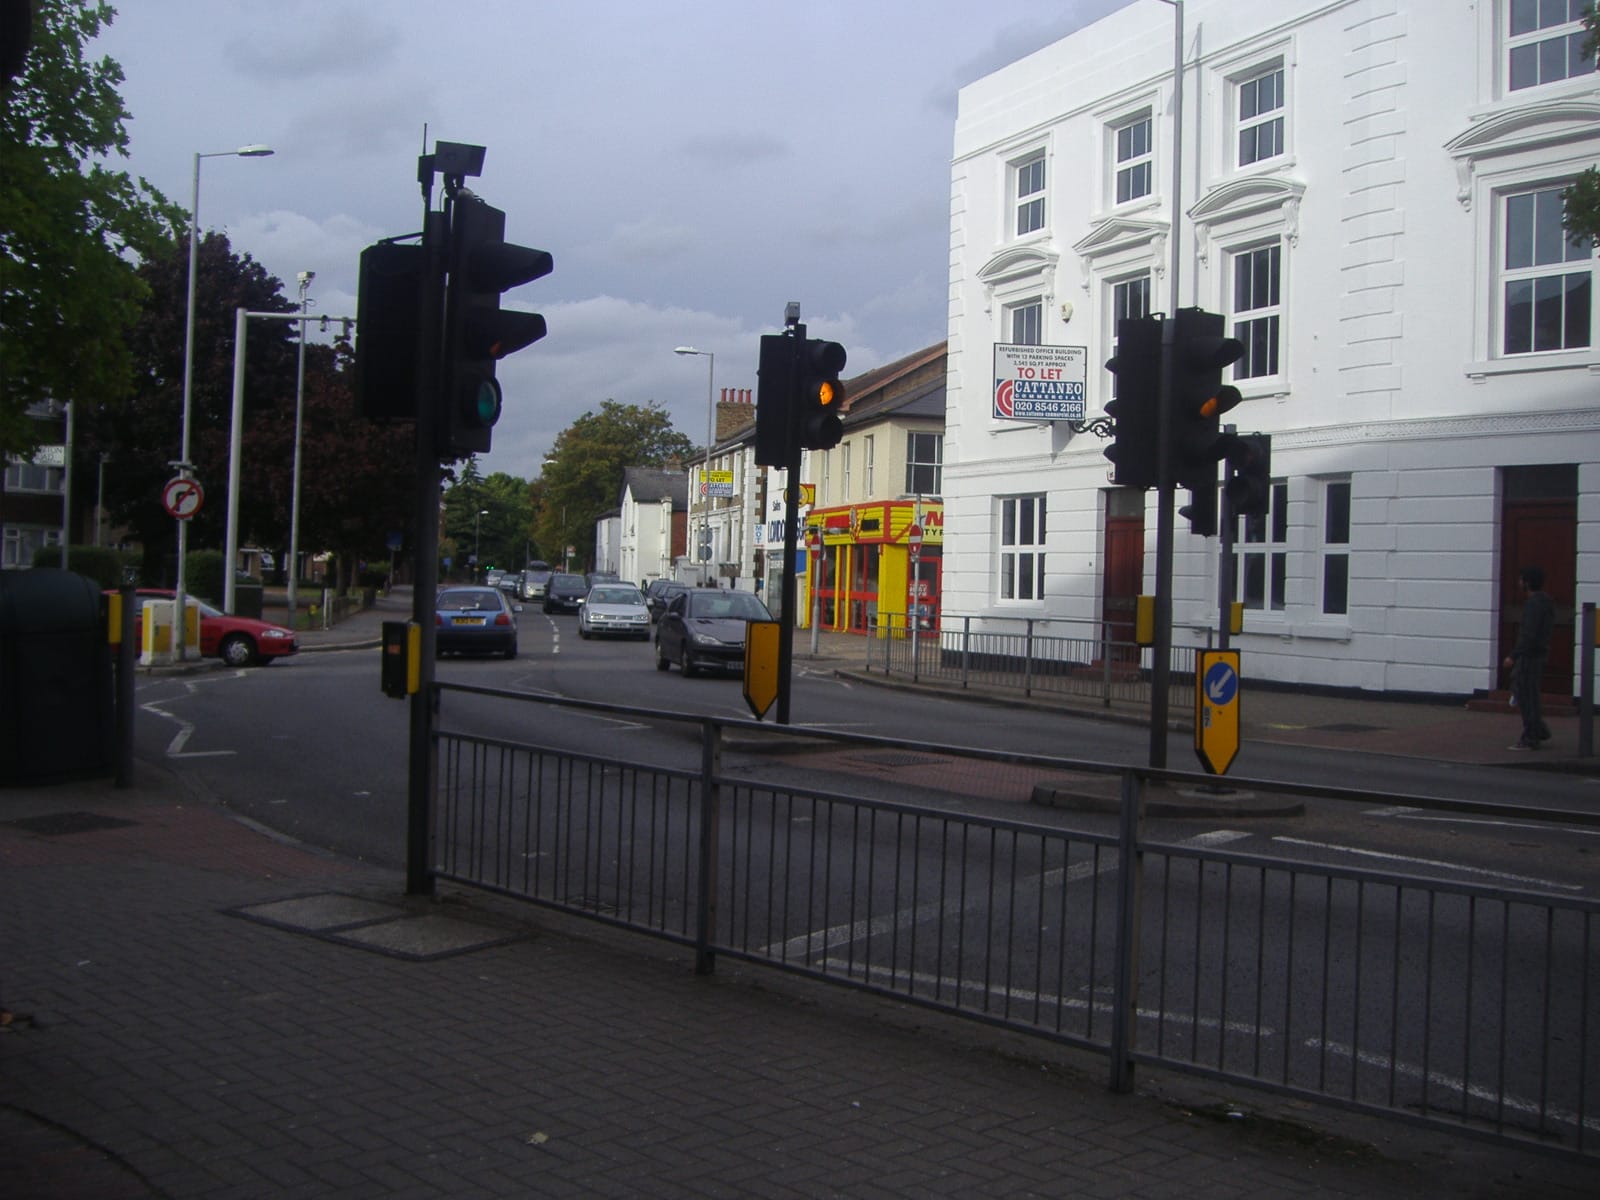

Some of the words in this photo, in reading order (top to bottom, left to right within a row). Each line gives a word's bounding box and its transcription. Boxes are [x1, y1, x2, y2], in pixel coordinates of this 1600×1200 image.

[1017, 367, 1035, 379] TO
[1040, 368, 1063, 380] LET
[1015, 381, 1082, 395] CATTANEO
[1015, 402, 1032, 411] 020
[1034, 402, 1058, 412] 8546
[1060, 403, 1081, 412] 2166
